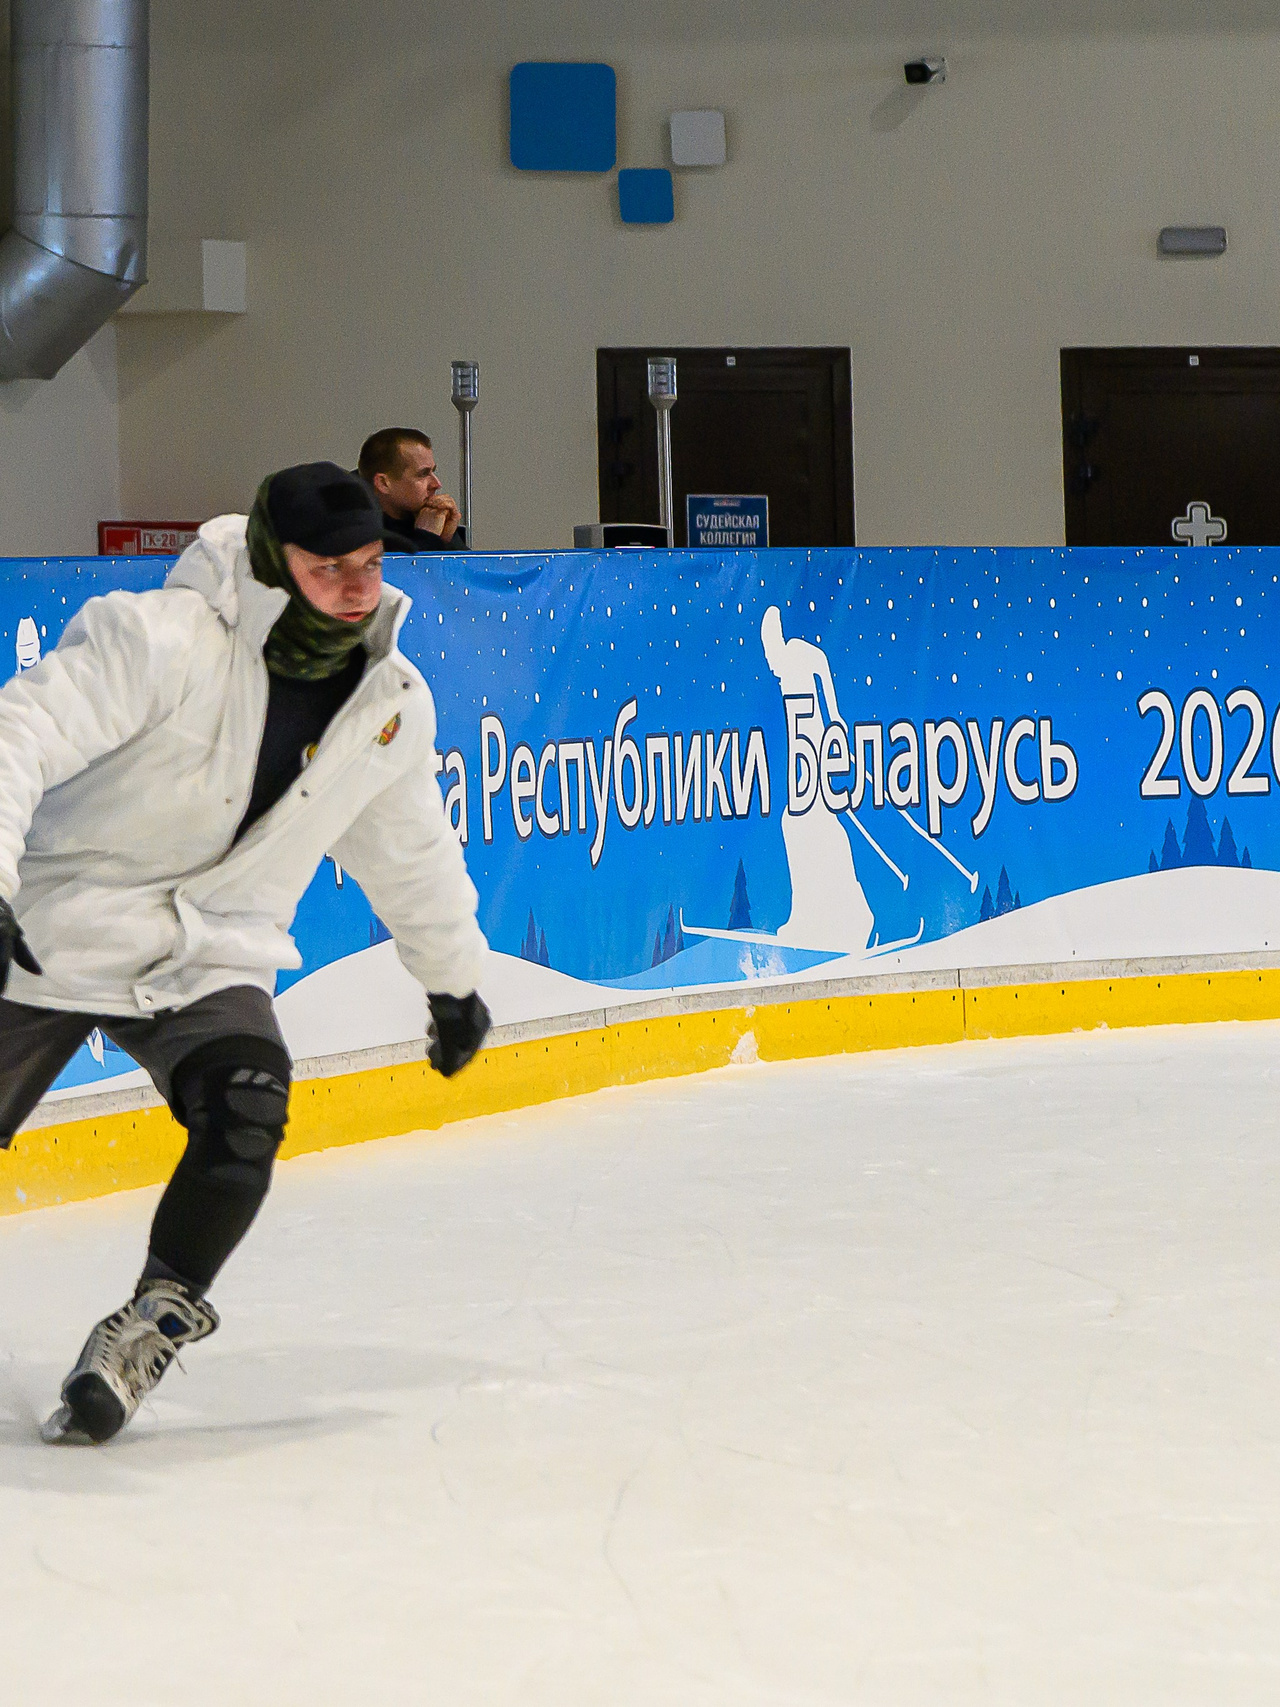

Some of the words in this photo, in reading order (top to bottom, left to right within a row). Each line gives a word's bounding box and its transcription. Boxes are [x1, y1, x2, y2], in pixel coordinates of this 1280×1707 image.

[695, 512, 760, 529] СУДЕЙСКАЯ
[699, 531, 757, 545] КОЛЛЕГИЯ
[479, 696, 770, 869] Республики
[783, 694, 1079, 838] Беларусь
[1137, 686, 1280, 798] 202
